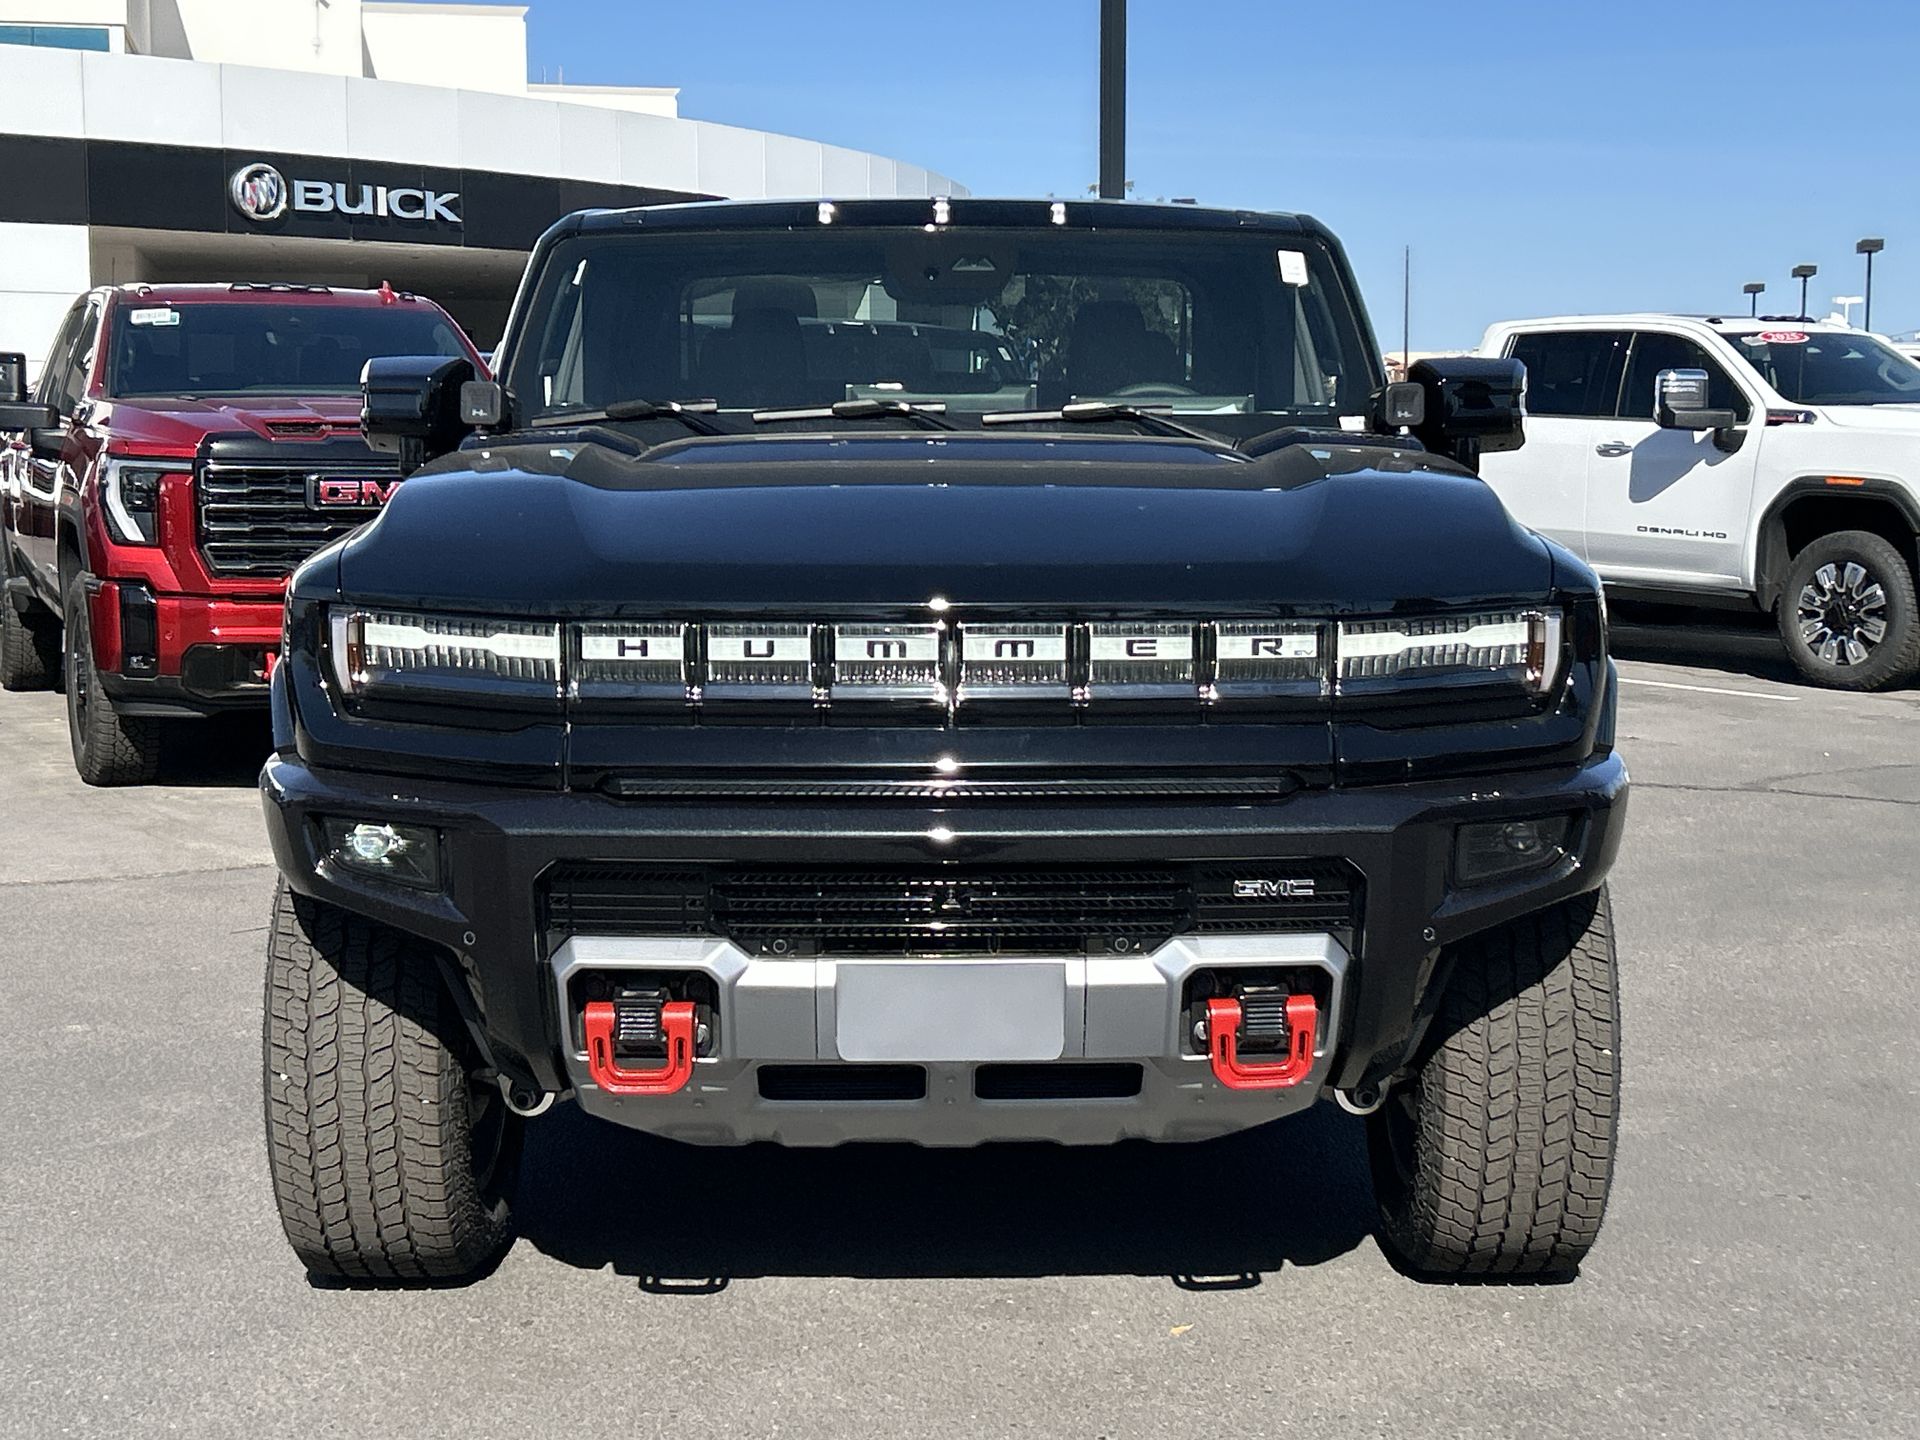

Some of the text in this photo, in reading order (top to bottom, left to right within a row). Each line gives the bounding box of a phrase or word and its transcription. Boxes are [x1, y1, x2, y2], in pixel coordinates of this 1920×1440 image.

[294, 180, 463, 223] BUICK
[320, 481, 400, 505] GM
[1636, 525, 1727, 539] DENALI HD
[1233, 879, 1315, 897] GMC
